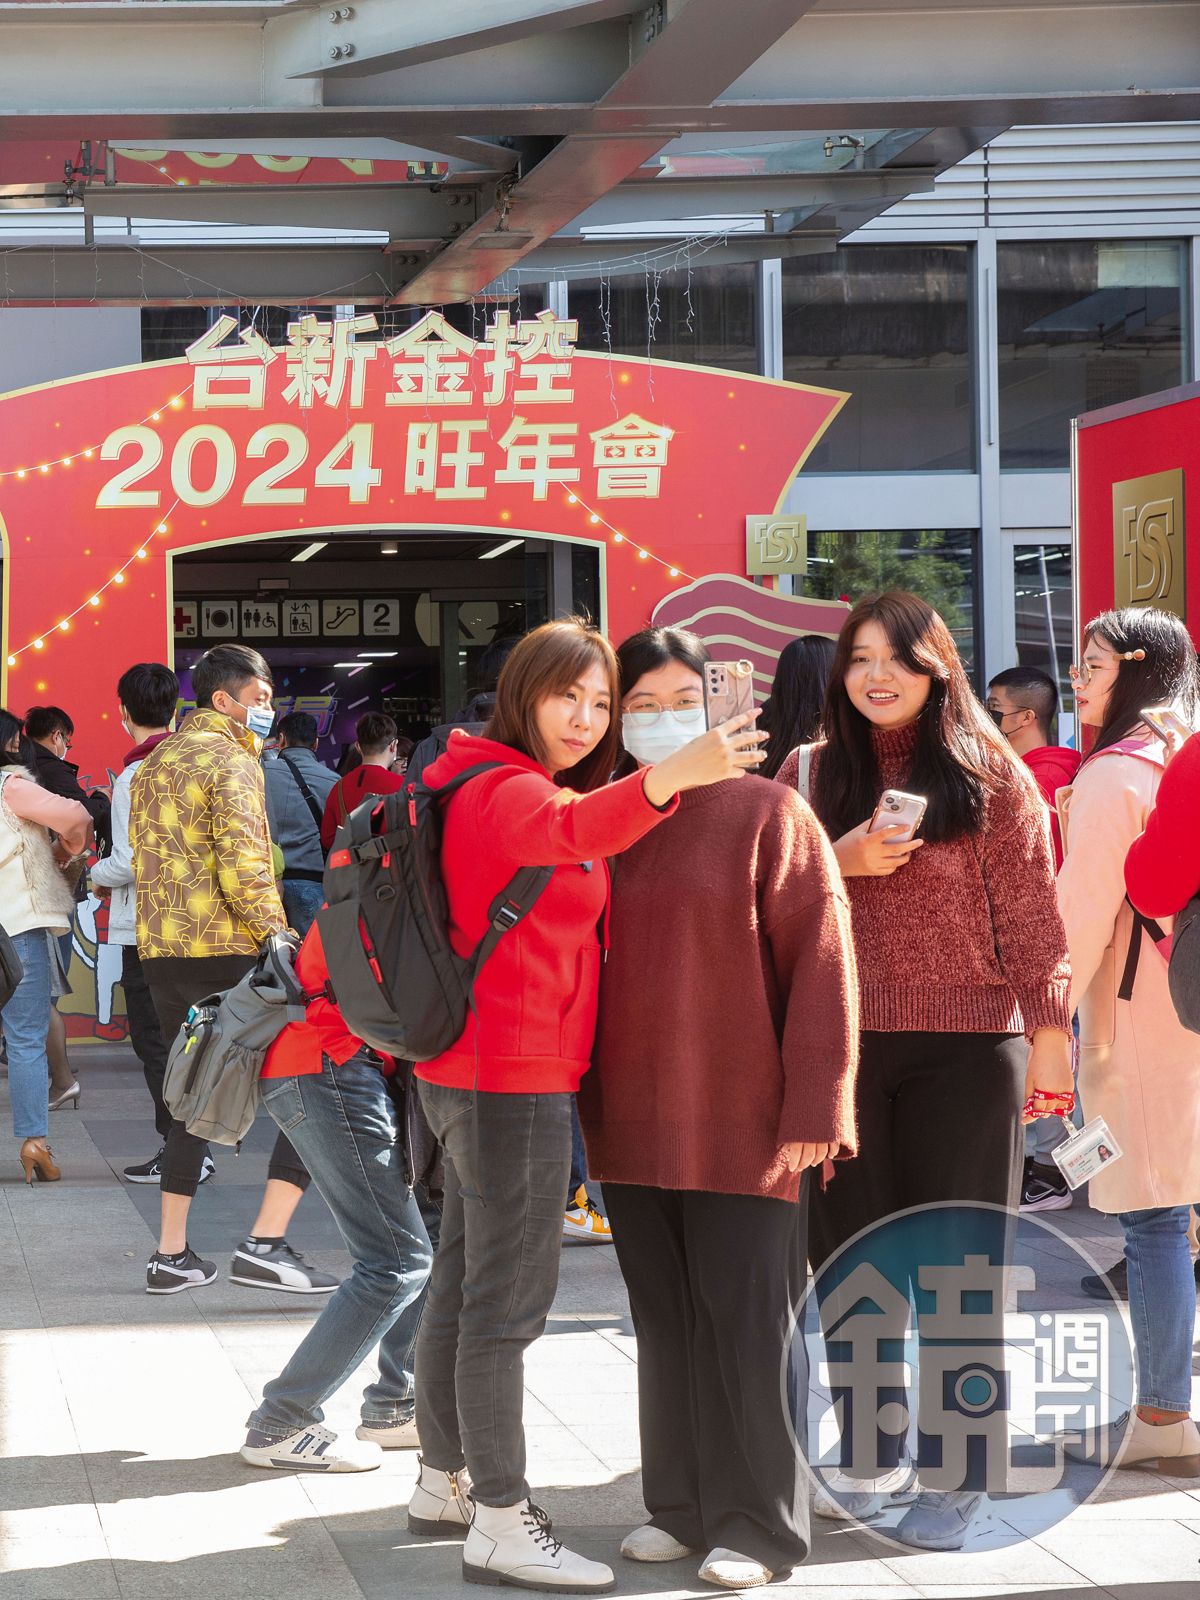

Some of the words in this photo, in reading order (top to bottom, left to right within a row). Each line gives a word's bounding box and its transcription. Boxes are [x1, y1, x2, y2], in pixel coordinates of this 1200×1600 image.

[184, 308, 580, 411] 台新金控
[374, 603, 390, 626] 2
